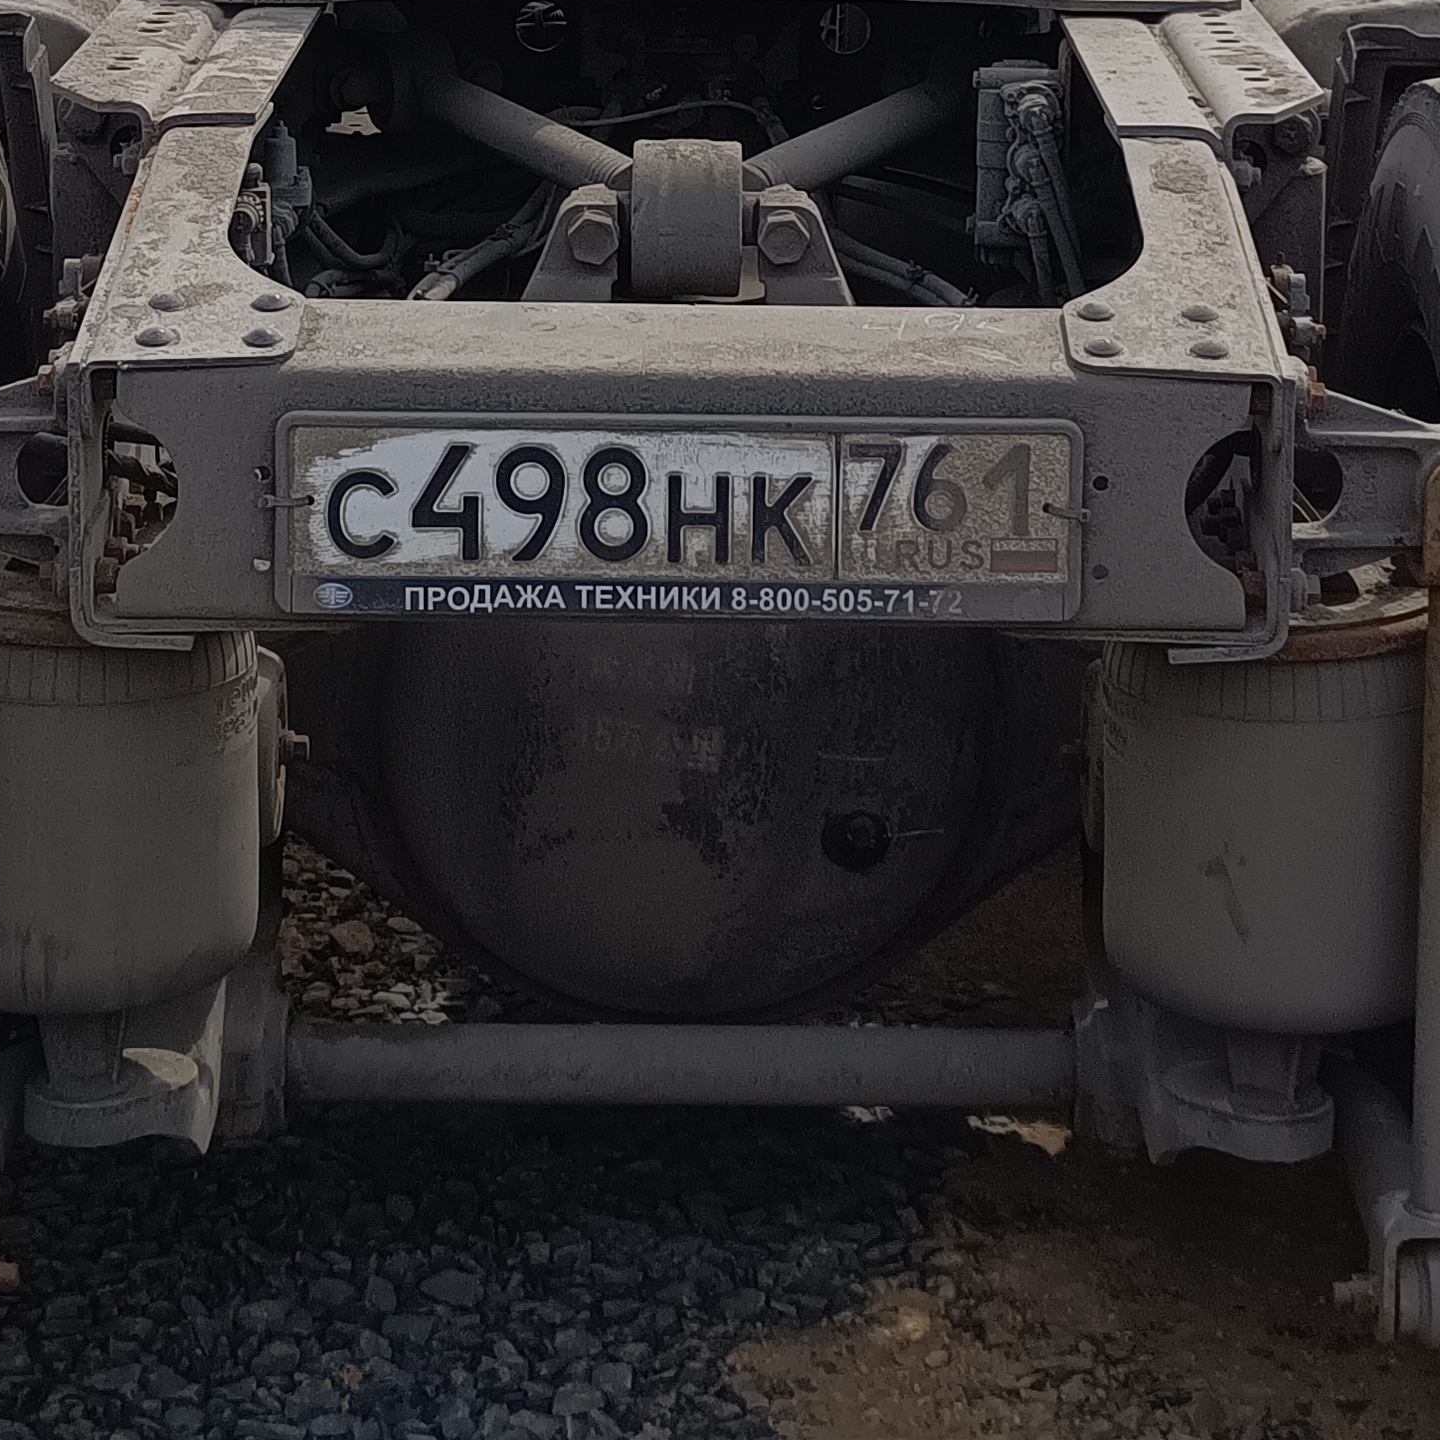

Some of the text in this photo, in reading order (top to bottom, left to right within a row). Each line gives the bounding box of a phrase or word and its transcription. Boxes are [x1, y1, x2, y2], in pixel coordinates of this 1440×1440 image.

[895, 539, 985, 571] RUS
[405, 584, 962, 613] ПРОДАЖА ТЕХНИКИ 8-800-505-71-72
